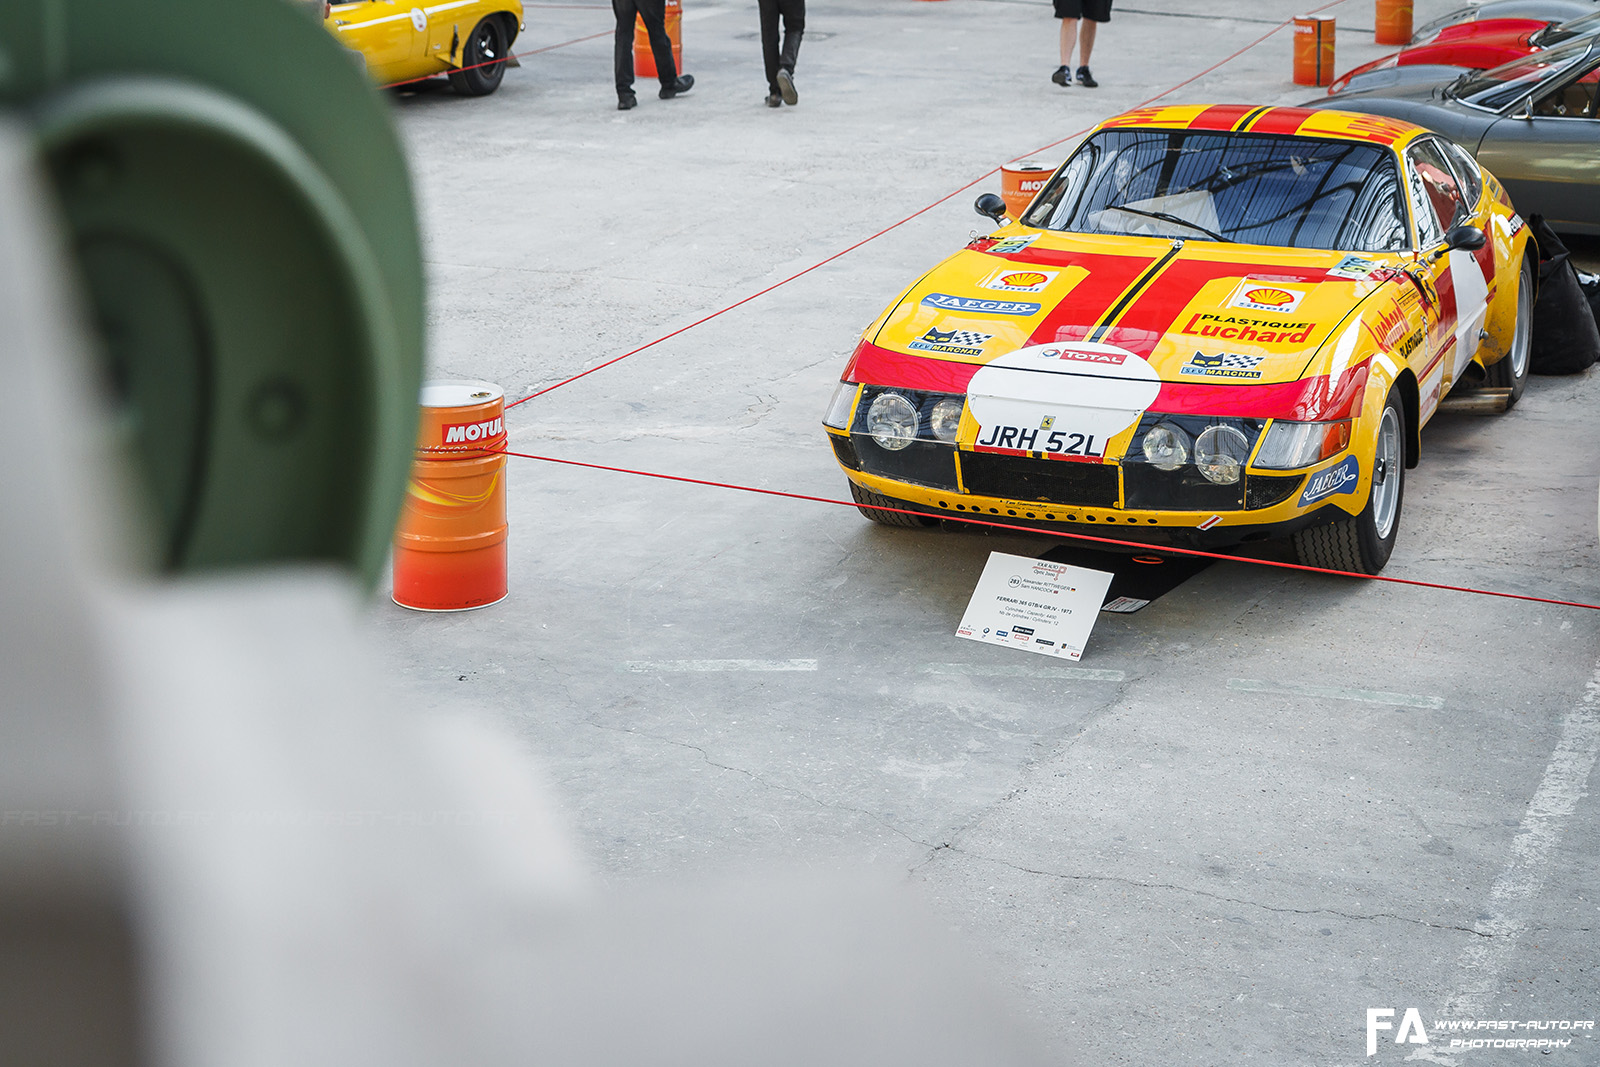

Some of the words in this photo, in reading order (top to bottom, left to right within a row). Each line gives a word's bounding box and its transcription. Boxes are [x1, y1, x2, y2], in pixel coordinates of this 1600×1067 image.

[927, 295, 1037, 313] JAEGER
[1181, 313, 1316, 343] Luchard
[1201, 314, 1308, 329] PLASTIQUE
[1361, 297, 1410, 354] Luchard
[931, 345, 980, 355] MARCHAL
[1399, 328, 1423, 359] PLASTIQUE
[1065, 351, 1122, 363] TOTAL
[1205, 369, 1261, 379] MARCHAL
[446, 417, 502, 443] MOTUL
[980, 425, 1038, 450] JRH
[1045, 431, 1101, 457] 52L
[1303, 464, 1353, 498] JAEGER
[996, 596, 1018, 604] FERRARI
